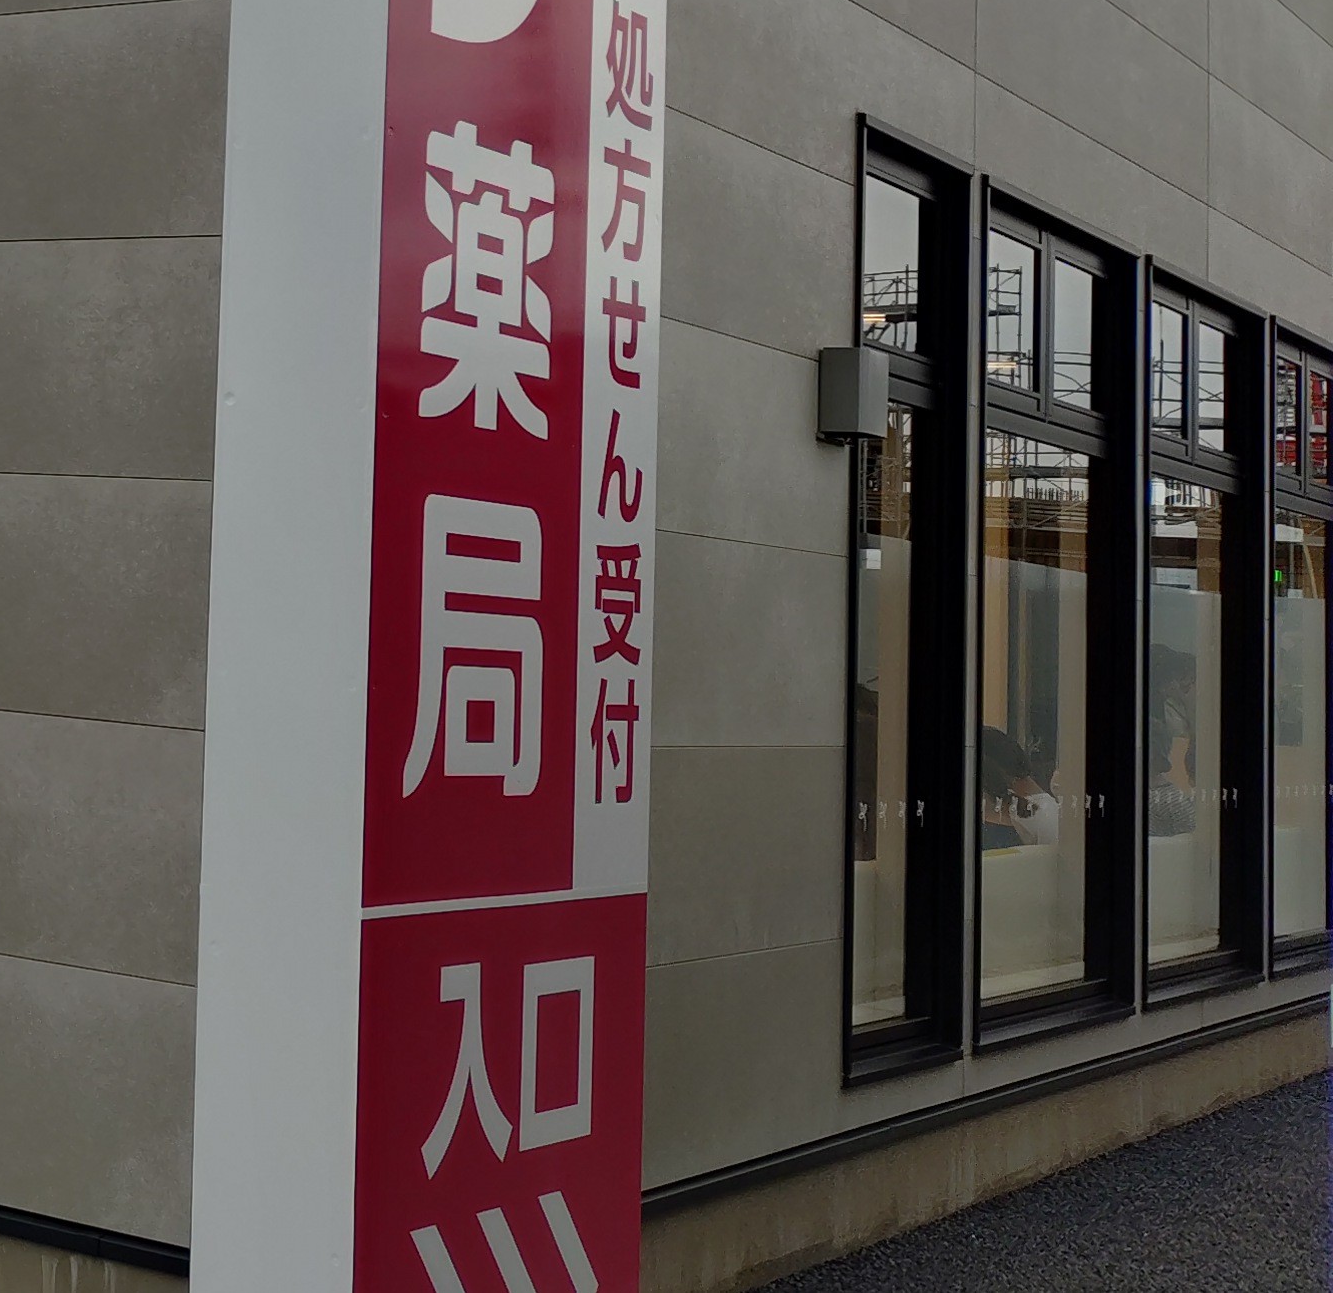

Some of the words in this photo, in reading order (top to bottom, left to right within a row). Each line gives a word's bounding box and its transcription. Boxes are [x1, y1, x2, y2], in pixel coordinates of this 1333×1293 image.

[590, 0, 654, 805] 処方せん受付
[420, 955, 595, 1181] 入口
